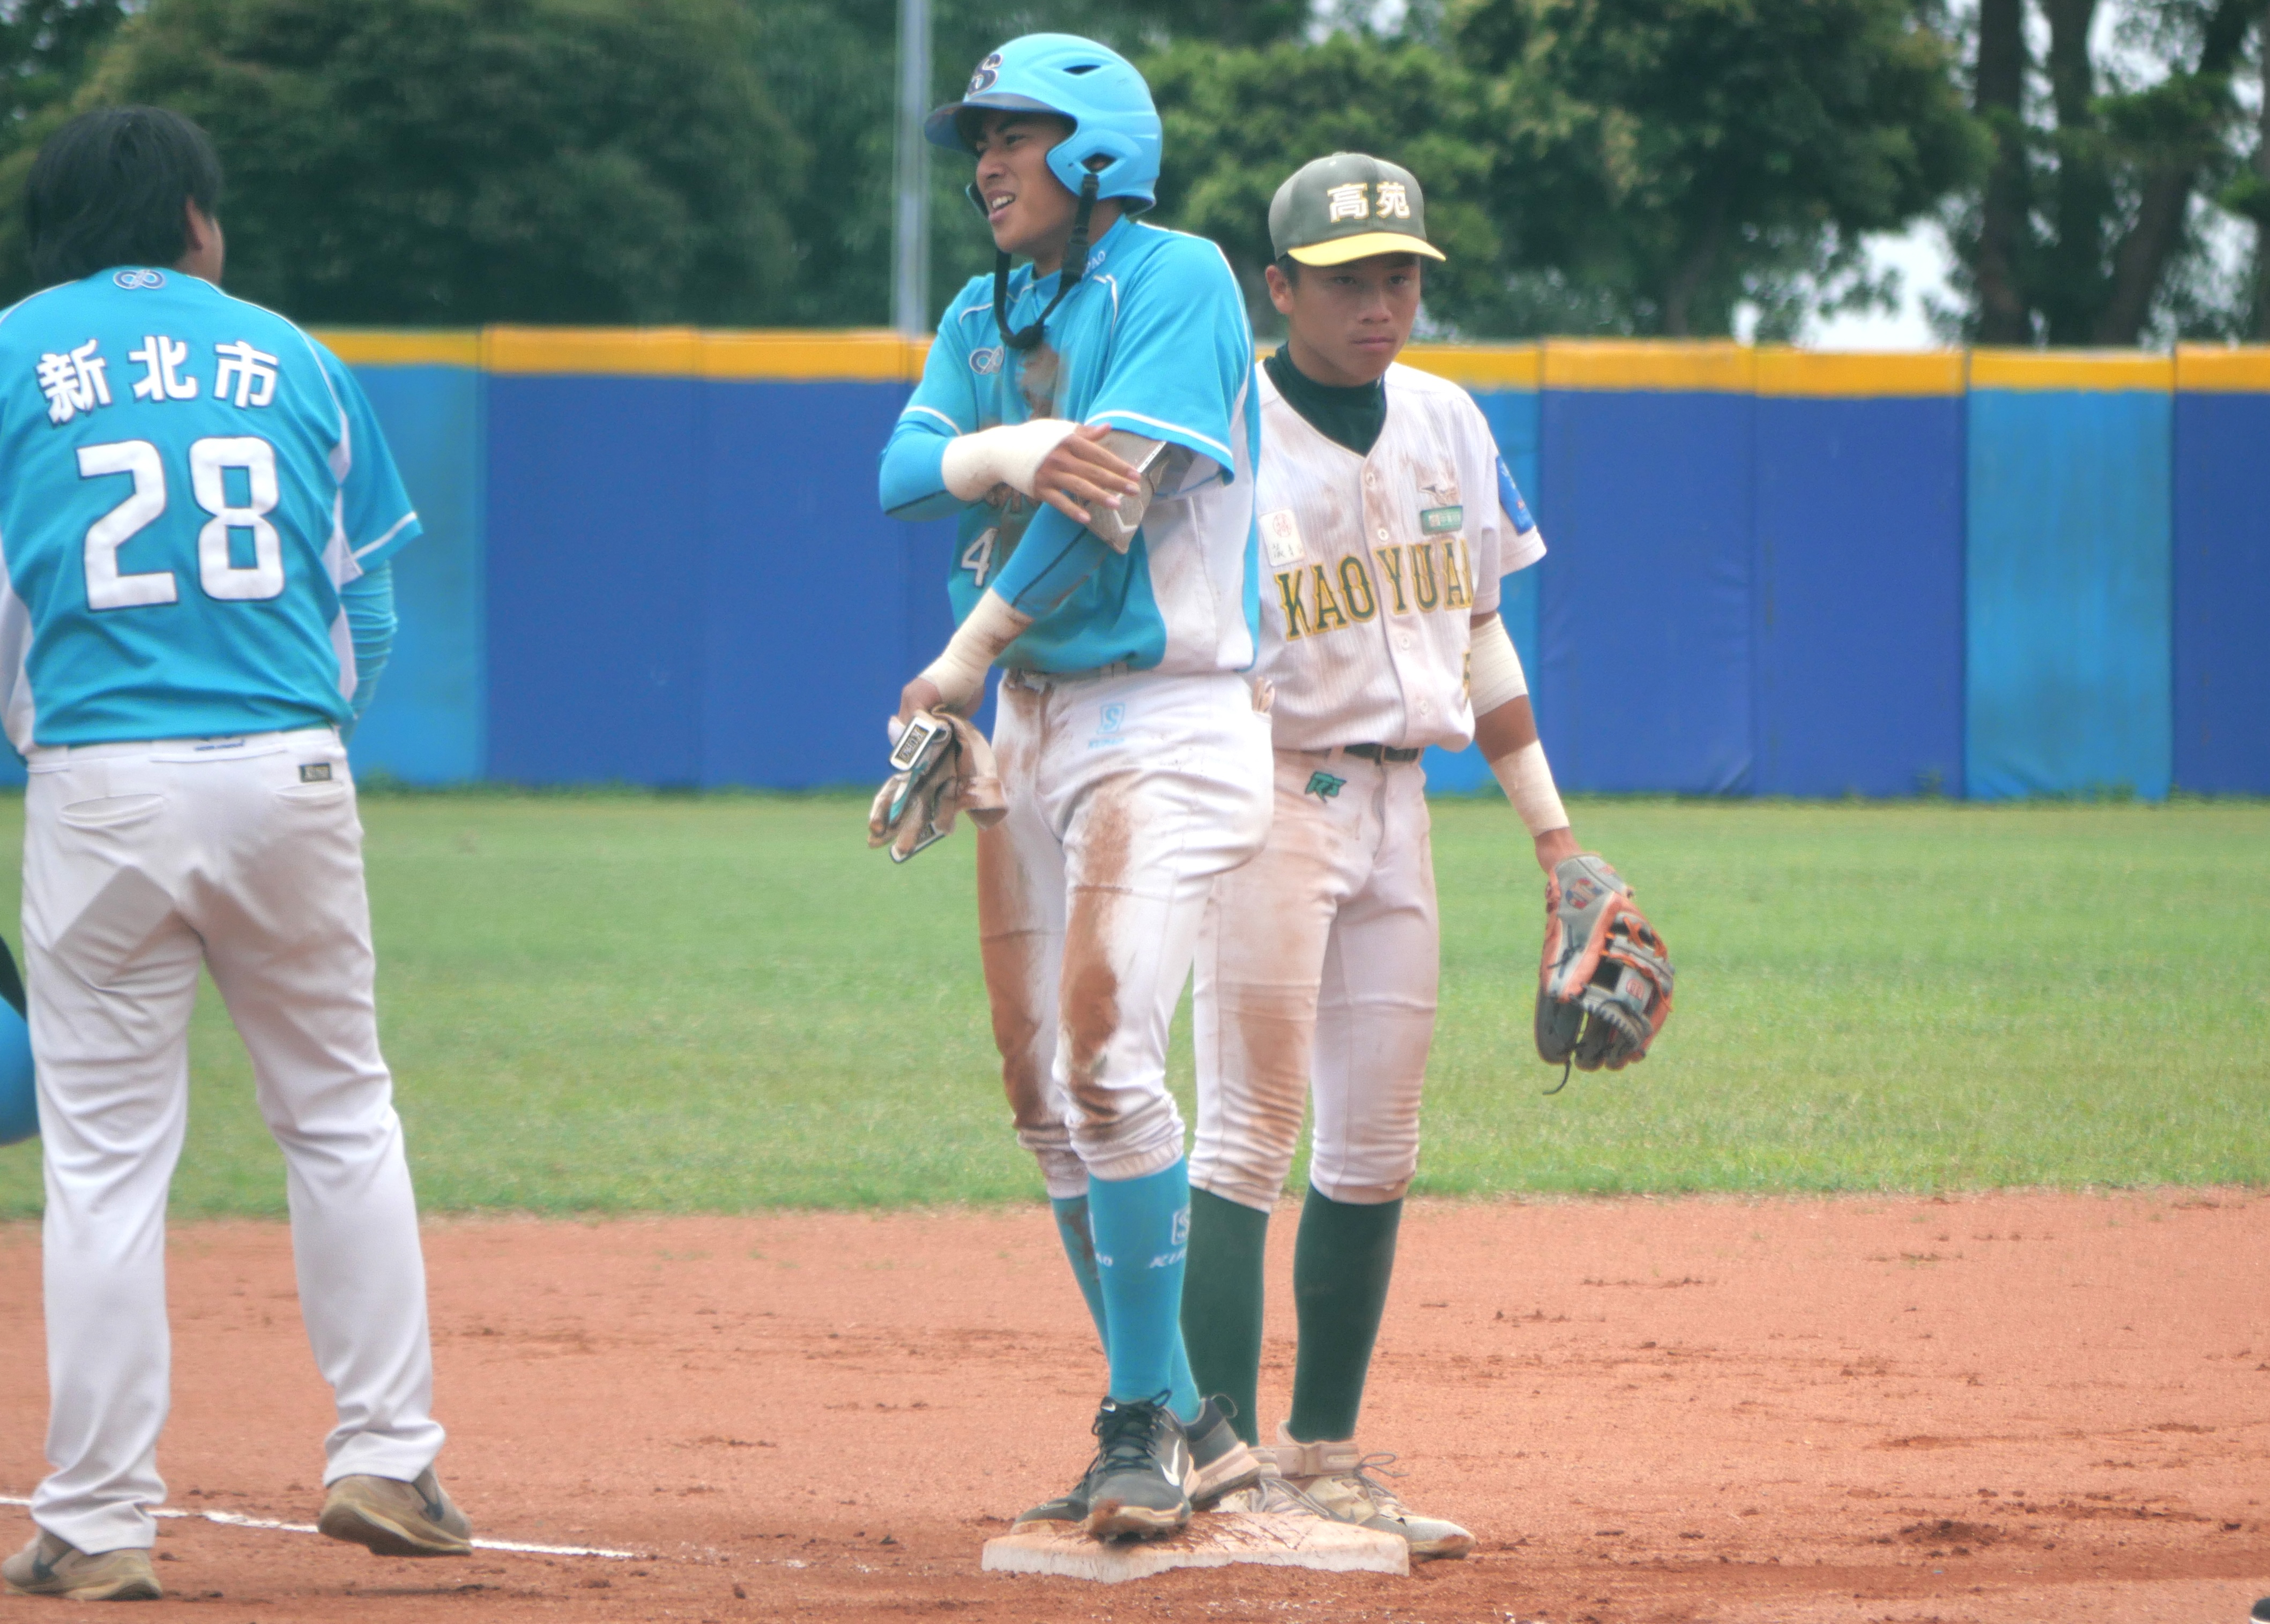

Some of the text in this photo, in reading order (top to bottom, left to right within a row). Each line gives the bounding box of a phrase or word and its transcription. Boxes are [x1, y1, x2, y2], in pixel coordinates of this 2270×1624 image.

[968, 53, 1003, 96] S
[1327, 181, 1411, 223] 高苑
[36, 335, 279, 425] 新北市
[77, 436, 285, 612] 28
[961, 527, 998, 586] 4
